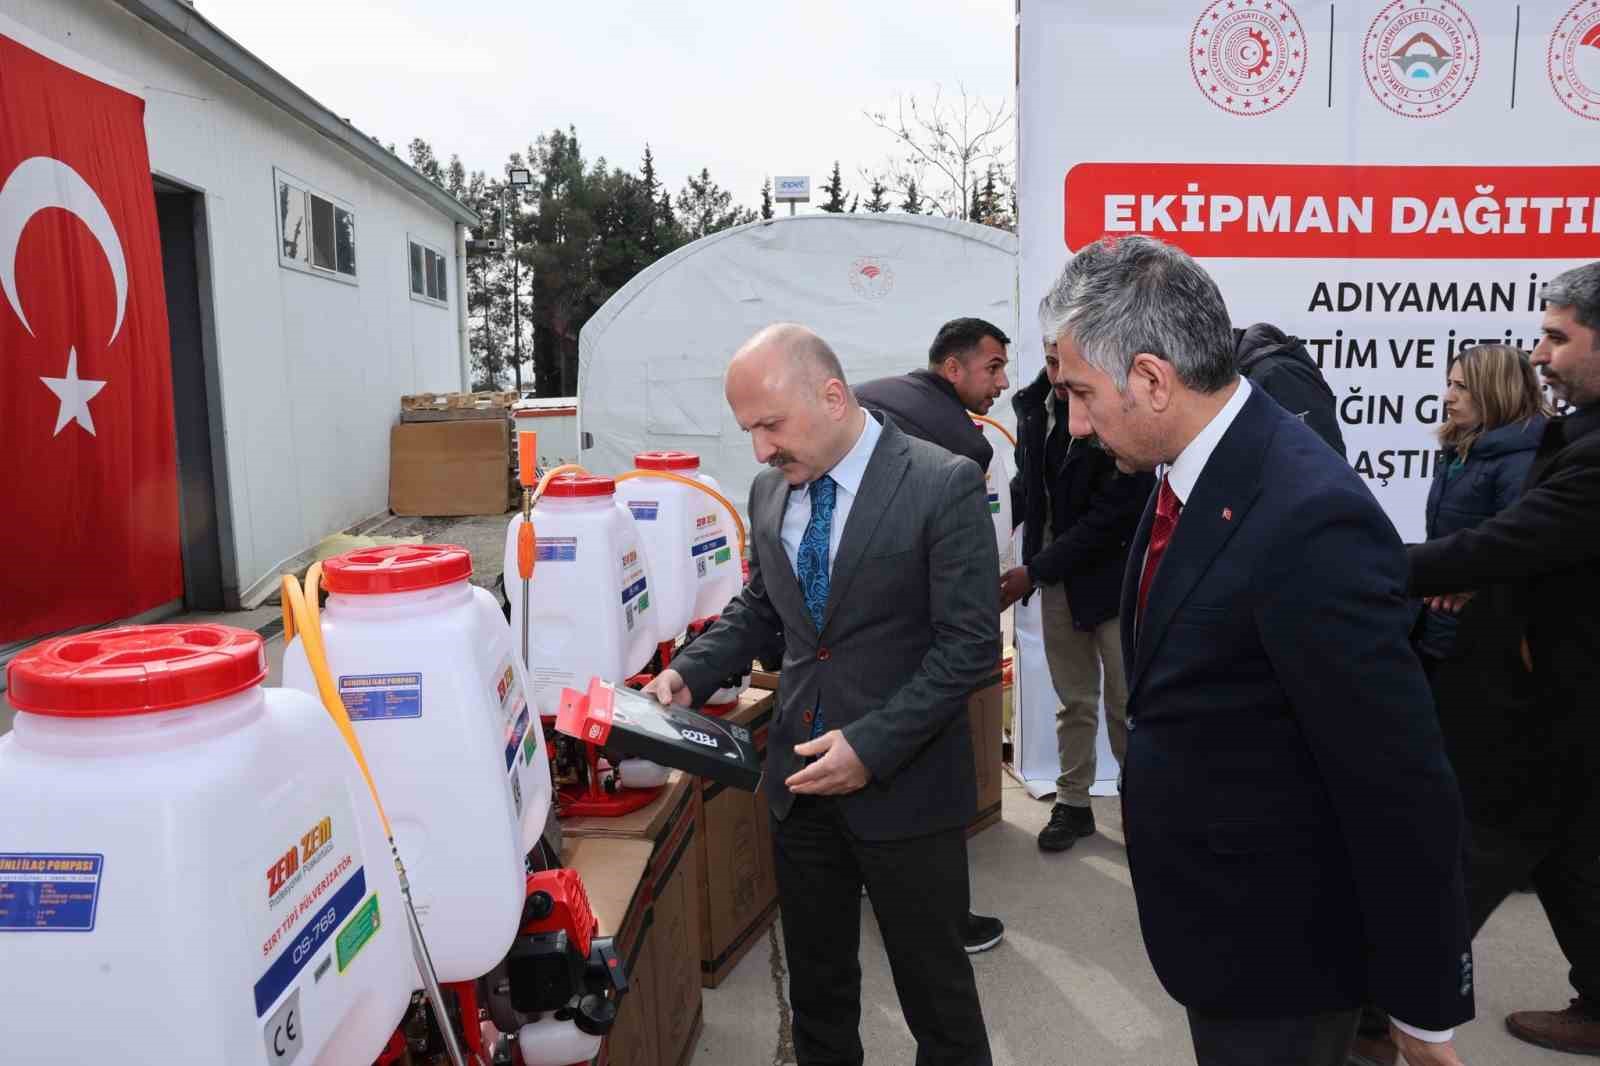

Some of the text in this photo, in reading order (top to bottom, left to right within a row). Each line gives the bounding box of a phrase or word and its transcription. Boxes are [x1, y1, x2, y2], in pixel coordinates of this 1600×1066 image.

[1104, 183, 1600, 235] EKİPMAN DAĞITI
[1308, 282, 1516, 312] ADIYAMAN
[1298, 329, 1378, 369] TİM
[1389, 339, 1435, 369] VE
[1335, 386, 1404, 425] ĞIN
[1354, 450, 1447, 487] AŞTI
[263, 929, 282, 956] SIRT
